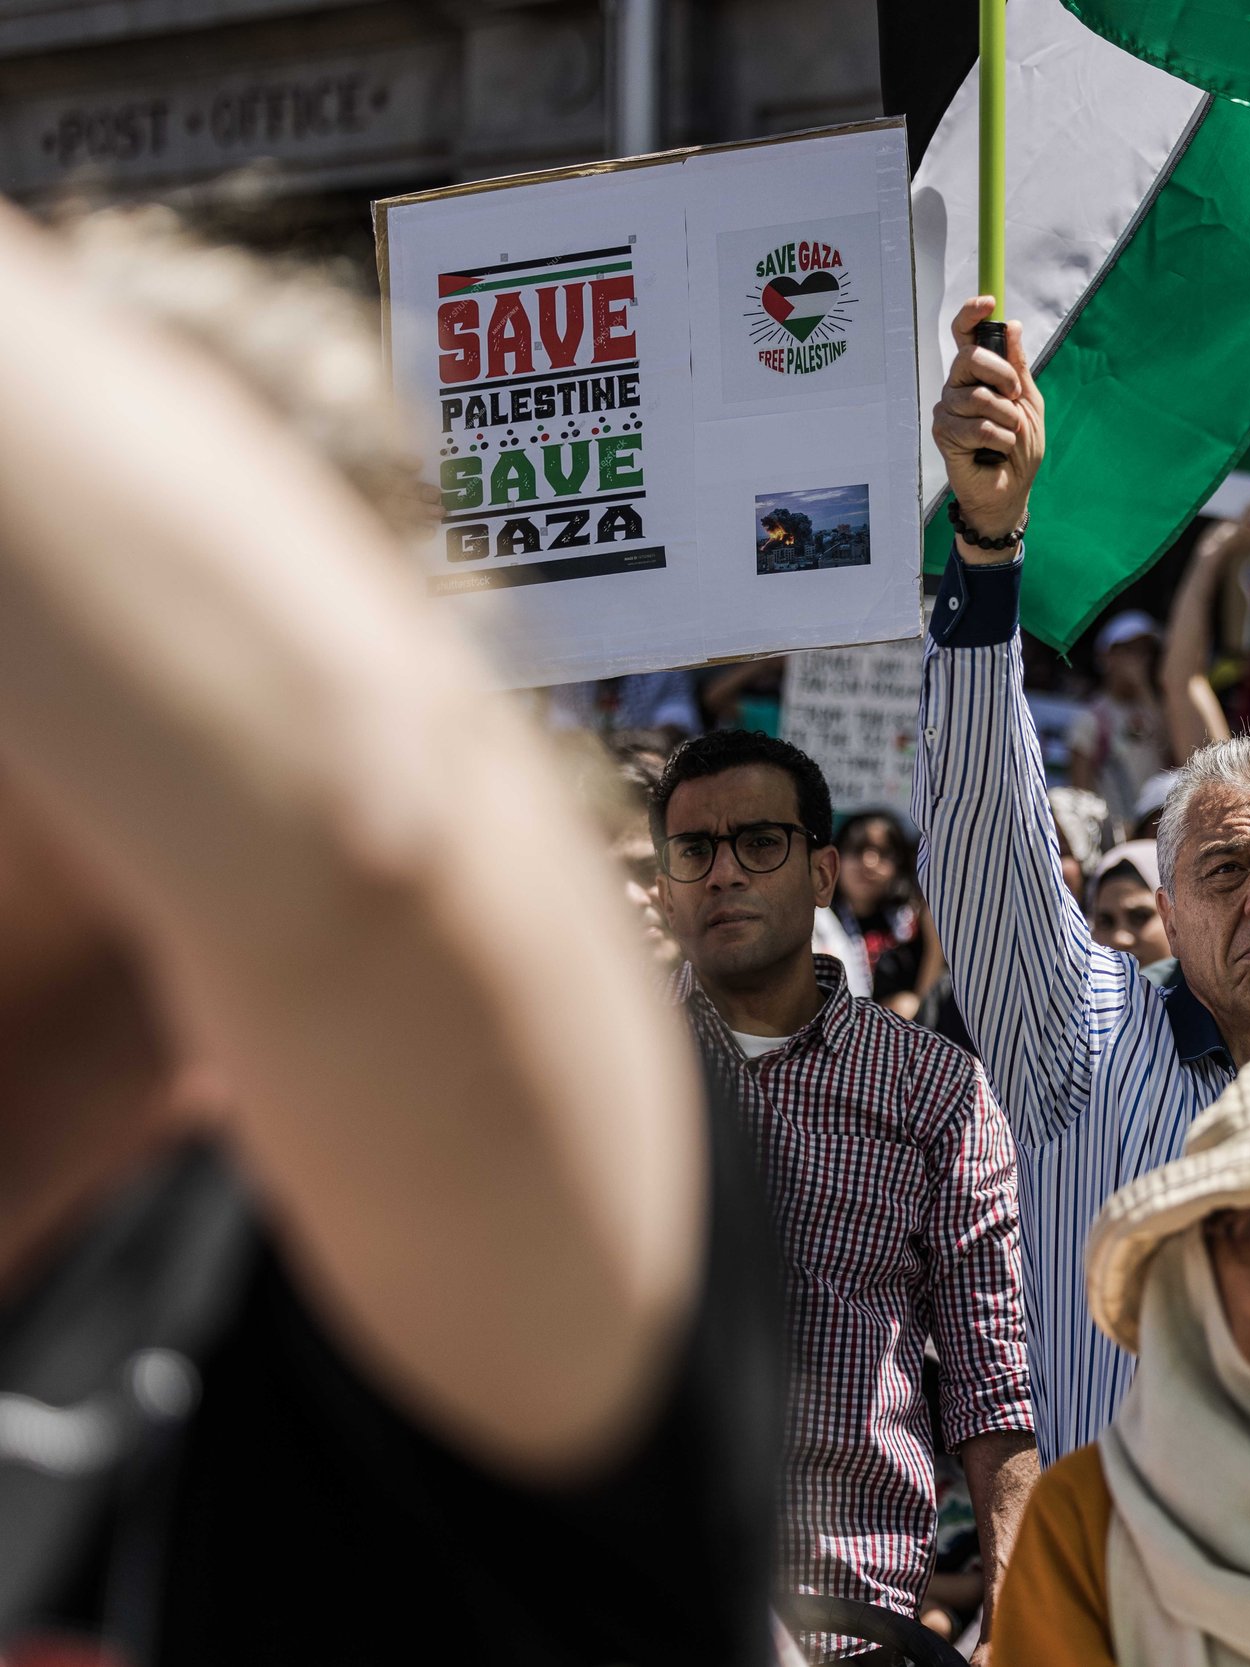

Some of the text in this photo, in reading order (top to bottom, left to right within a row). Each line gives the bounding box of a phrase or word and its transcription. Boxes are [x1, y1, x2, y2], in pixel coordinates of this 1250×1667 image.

[756, 241, 843, 277] SAVE GAZA
[438, 275, 637, 384] SAVE
[758, 340, 847, 375] FREE PALESTINE
[440, 373, 641, 433] PALESTINE
[440, 433, 644, 511] SAVE
[446, 503, 646, 563] GAZA
